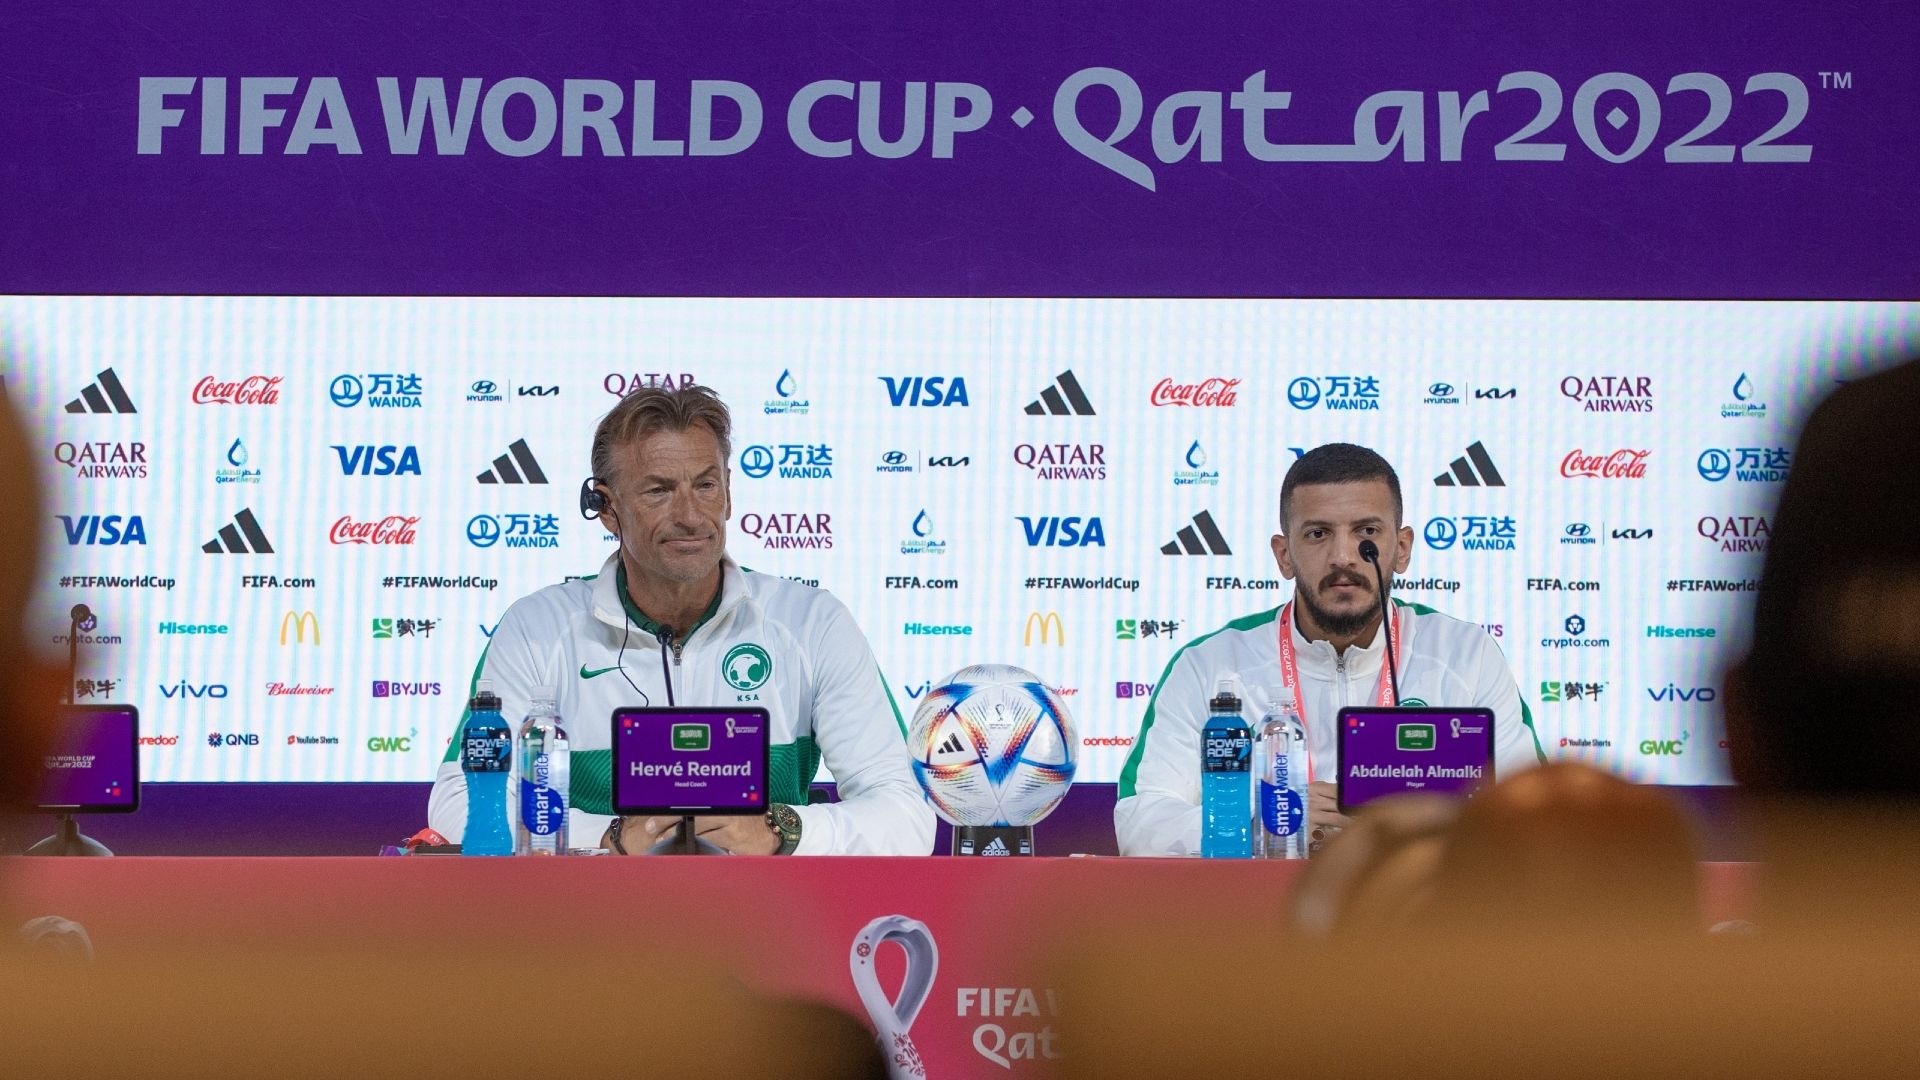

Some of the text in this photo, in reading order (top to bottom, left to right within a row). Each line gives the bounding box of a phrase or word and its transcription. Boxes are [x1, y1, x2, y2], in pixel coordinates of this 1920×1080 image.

[136, 76, 363, 155] FIFA
[377, 76, 763, 158] WORLD
[787, 79, 993, 159] CUP
[192, 375, 285, 405] Coca-Cola
[368, 373, 422, 395] 万达
[877, 376, 969, 406] VISA
[1325, 376, 1380, 397] 万达
[1560, 376, 1652, 401] QATAR
[1151, 377, 1242, 407] Coca-Cola
[368, 396, 422, 408] WANDA
[1326, 399, 1379, 410] WANDA
[1584, 400, 1653, 412] AIRWAYS
[54, 442, 147, 467] QATAR
[329, 445, 422, 475] VISA
[779, 444, 832, 466] 万达
[1013, 444, 1105, 469] QATAR
[1560, 449, 1652, 479] Coca-Cola
[78, 466, 147, 479] AIRWAYS
[779, 467, 832, 479] WANDA
[1037, 468, 1106, 480] AIRWAYS
[54, 515, 147, 545] VISA
[329, 515, 422, 545] Coca-Cola
[505, 513, 559, 535] 万达
[740, 513, 831, 538] QATAR
[1013, 516, 1106, 547] VISA
[1462, 515, 1516, 537] 万达
[506, 536, 559, 548] WANDA
[764, 537, 833, 549] AIRWAYS
[1463, 539, 1516, 550] WANDA
[59, 575, 176, 590] #FIFAWorldCup
[242, 575, 316, 588] FIFA.com
[382, 576, 498, 591] #FIFAWorldCup
[885, 577, 958, 590] FIFA.com
[1025, 577, 1140, 592] #FIFAWorldCup
[1206, 577, 1279, 590] FIFA.com
[1527, 578, 1600, 591] FIFA.com
[1666, 580, 1762, 592] #FIFAWorld
[159, 622, 228, 635] Hisense
[904, 623, 973, 635] Hisense
[1647, 626, 1716, 638] Hisense
[1541, 637, 1610, 649] crypto.com
[159, 680, 228, 698] vivo
[265, 682, 335, 697] Budweiser
[391, 683, 441, 696] BYJU'S
[1648, 684, 1715, 702] vivo
[226, 733, 259, 746] QNB
[367, 736, 411, 753] GWC
[467, 738, 510, 748] POWER
[1083, 736, 1132, 746] ooredoo
[1207, 738, 1250, 748] POWER
[467, 748, 493, 757] ADE
[1207, 748, 1233, 757] ADE
[1639, 740, 1682, 755] GWC
[630, 760, 751, 777] Hervé Renard
[1350, 764, 1482, 779] Abdulelah Almalki
[533, 752, 549, 834] smartwater
[1273, 752, 1289, 835] smartwater
[981, 848, 1010, 857] adidas
[957, 987, 1041, 1017] FIFA
